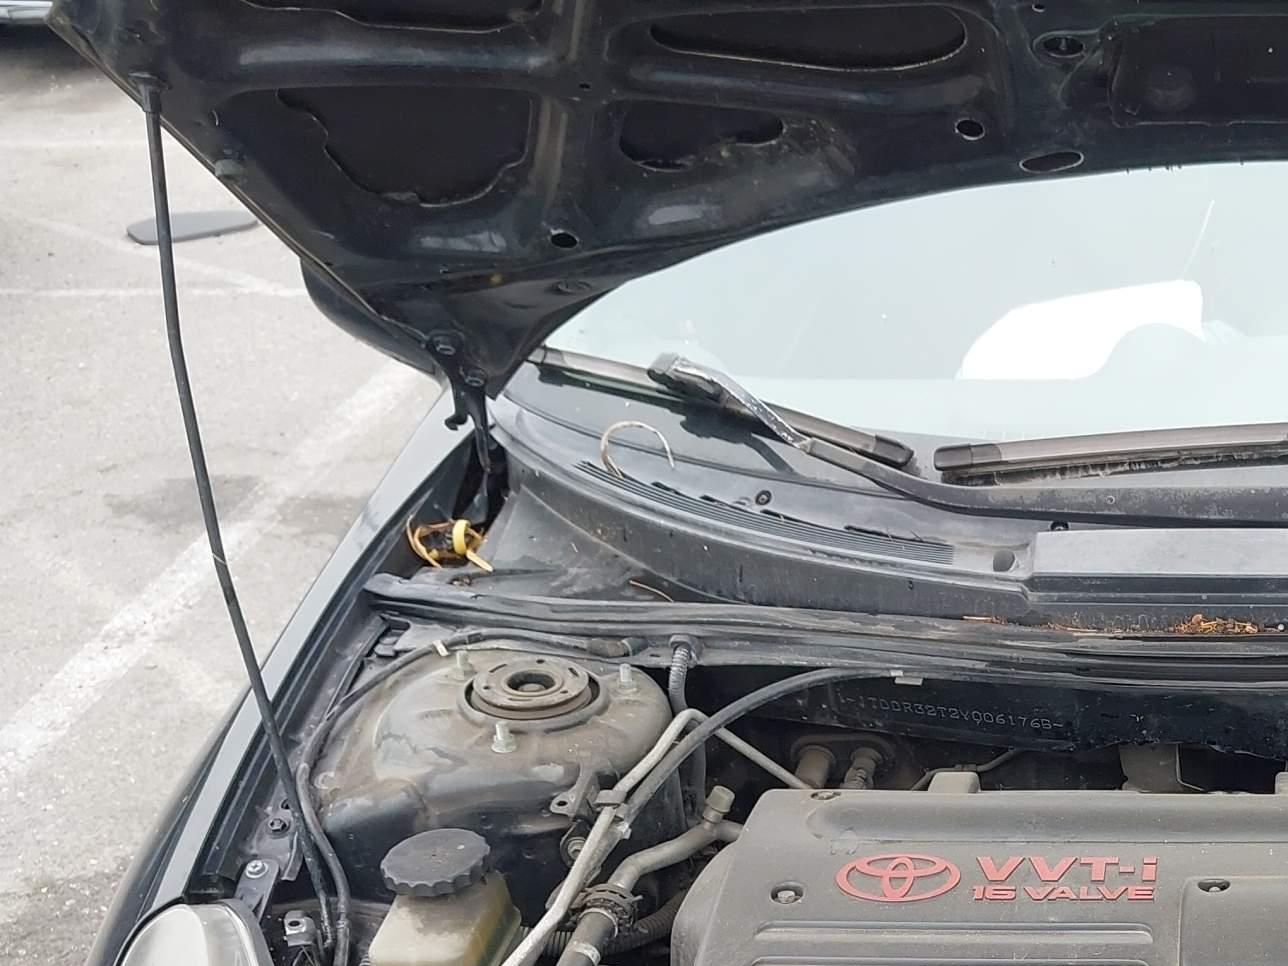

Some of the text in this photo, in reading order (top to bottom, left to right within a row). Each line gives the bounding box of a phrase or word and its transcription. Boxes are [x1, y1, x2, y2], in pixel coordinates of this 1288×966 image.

[975, 855, 1158, 883] VVT-i
[973, 885, 1156, 902] 16 VALVE
